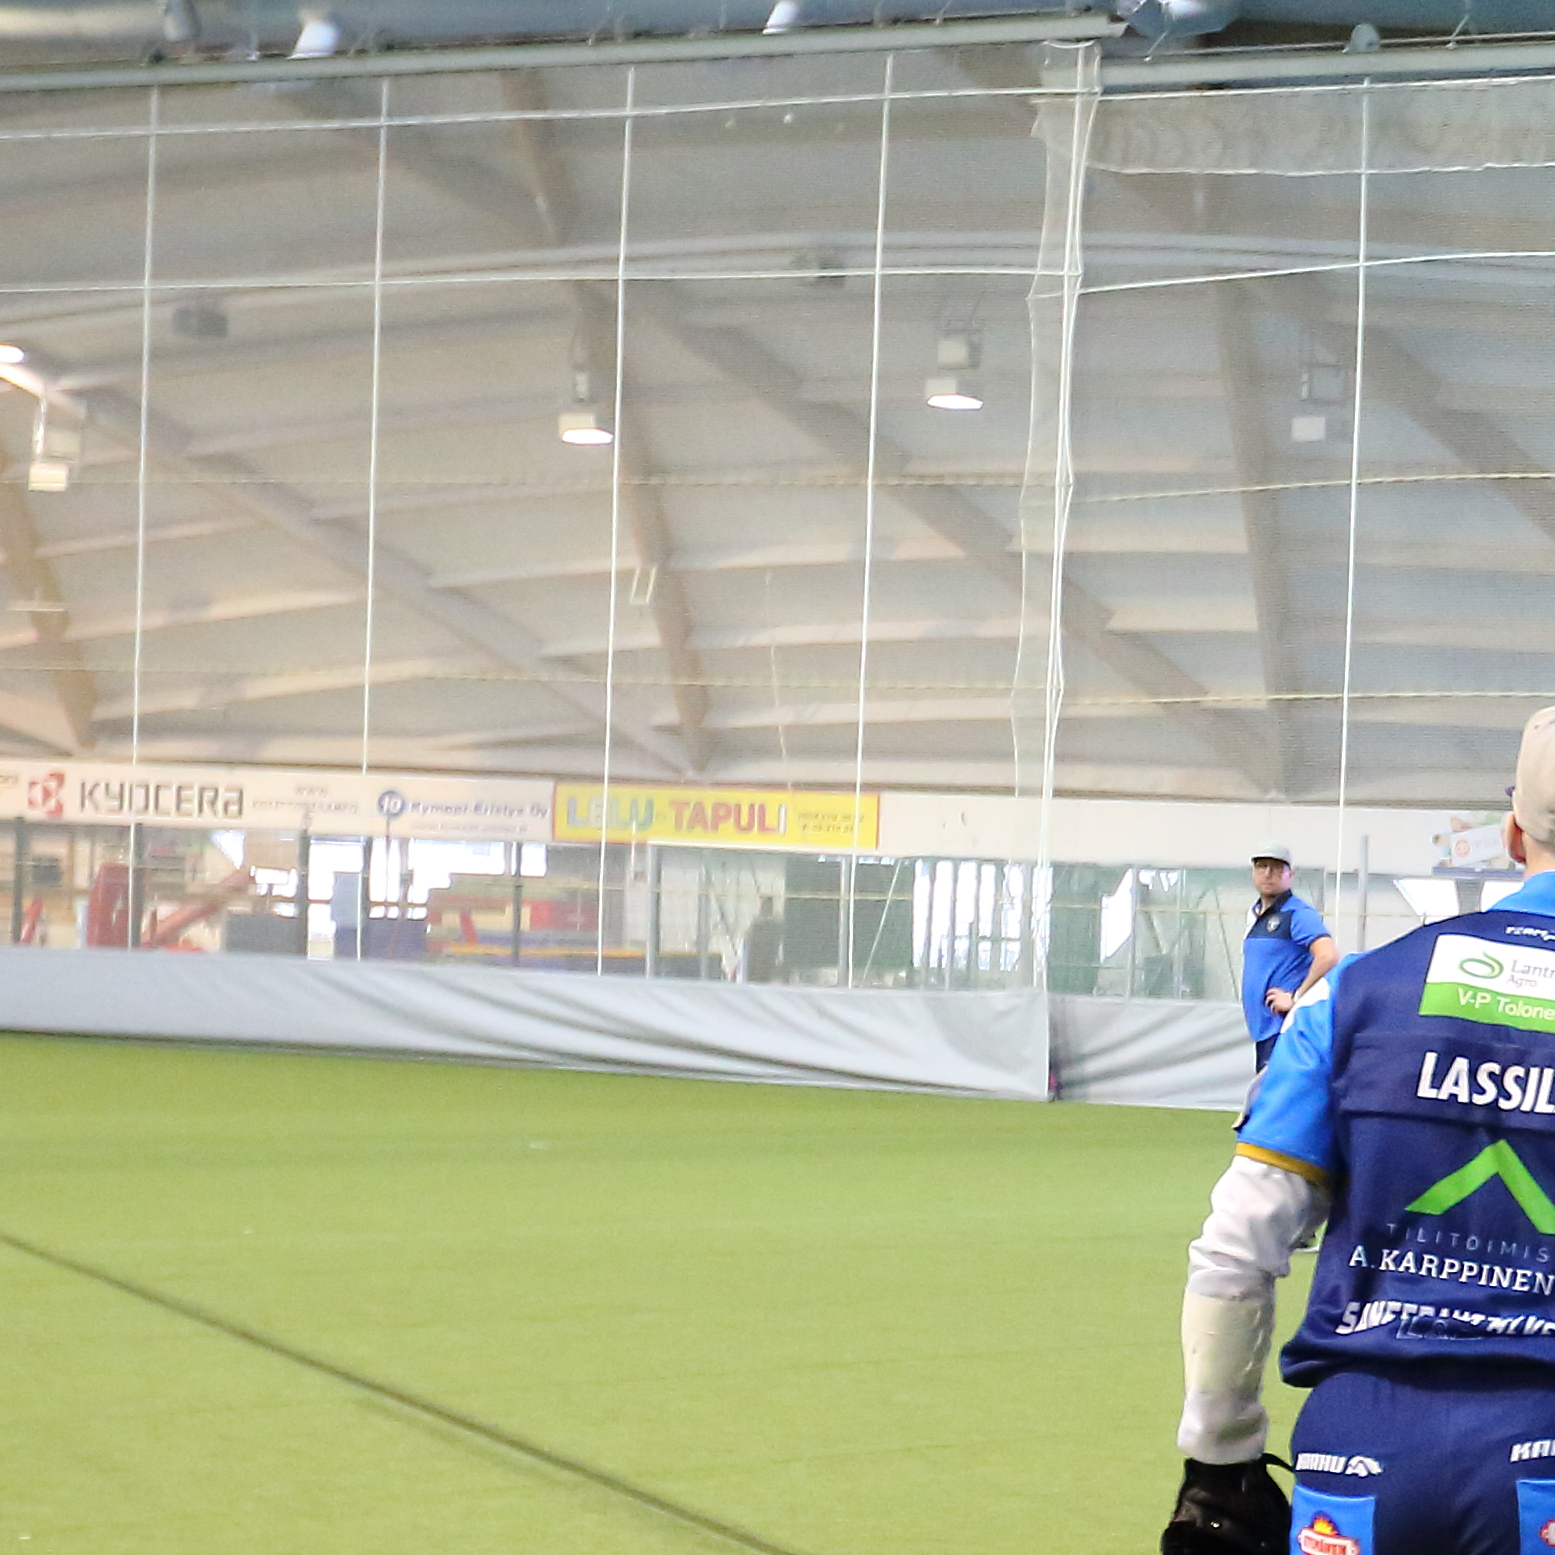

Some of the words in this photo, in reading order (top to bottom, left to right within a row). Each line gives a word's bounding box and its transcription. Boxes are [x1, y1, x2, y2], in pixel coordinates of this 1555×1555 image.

[80, 781, 244, 819] KYOCERA
[668, 799, 788, 836] TAPULI
[1506, 974, 1538, 989] Agro
[1457, 987, 1491, 1009] V-P
